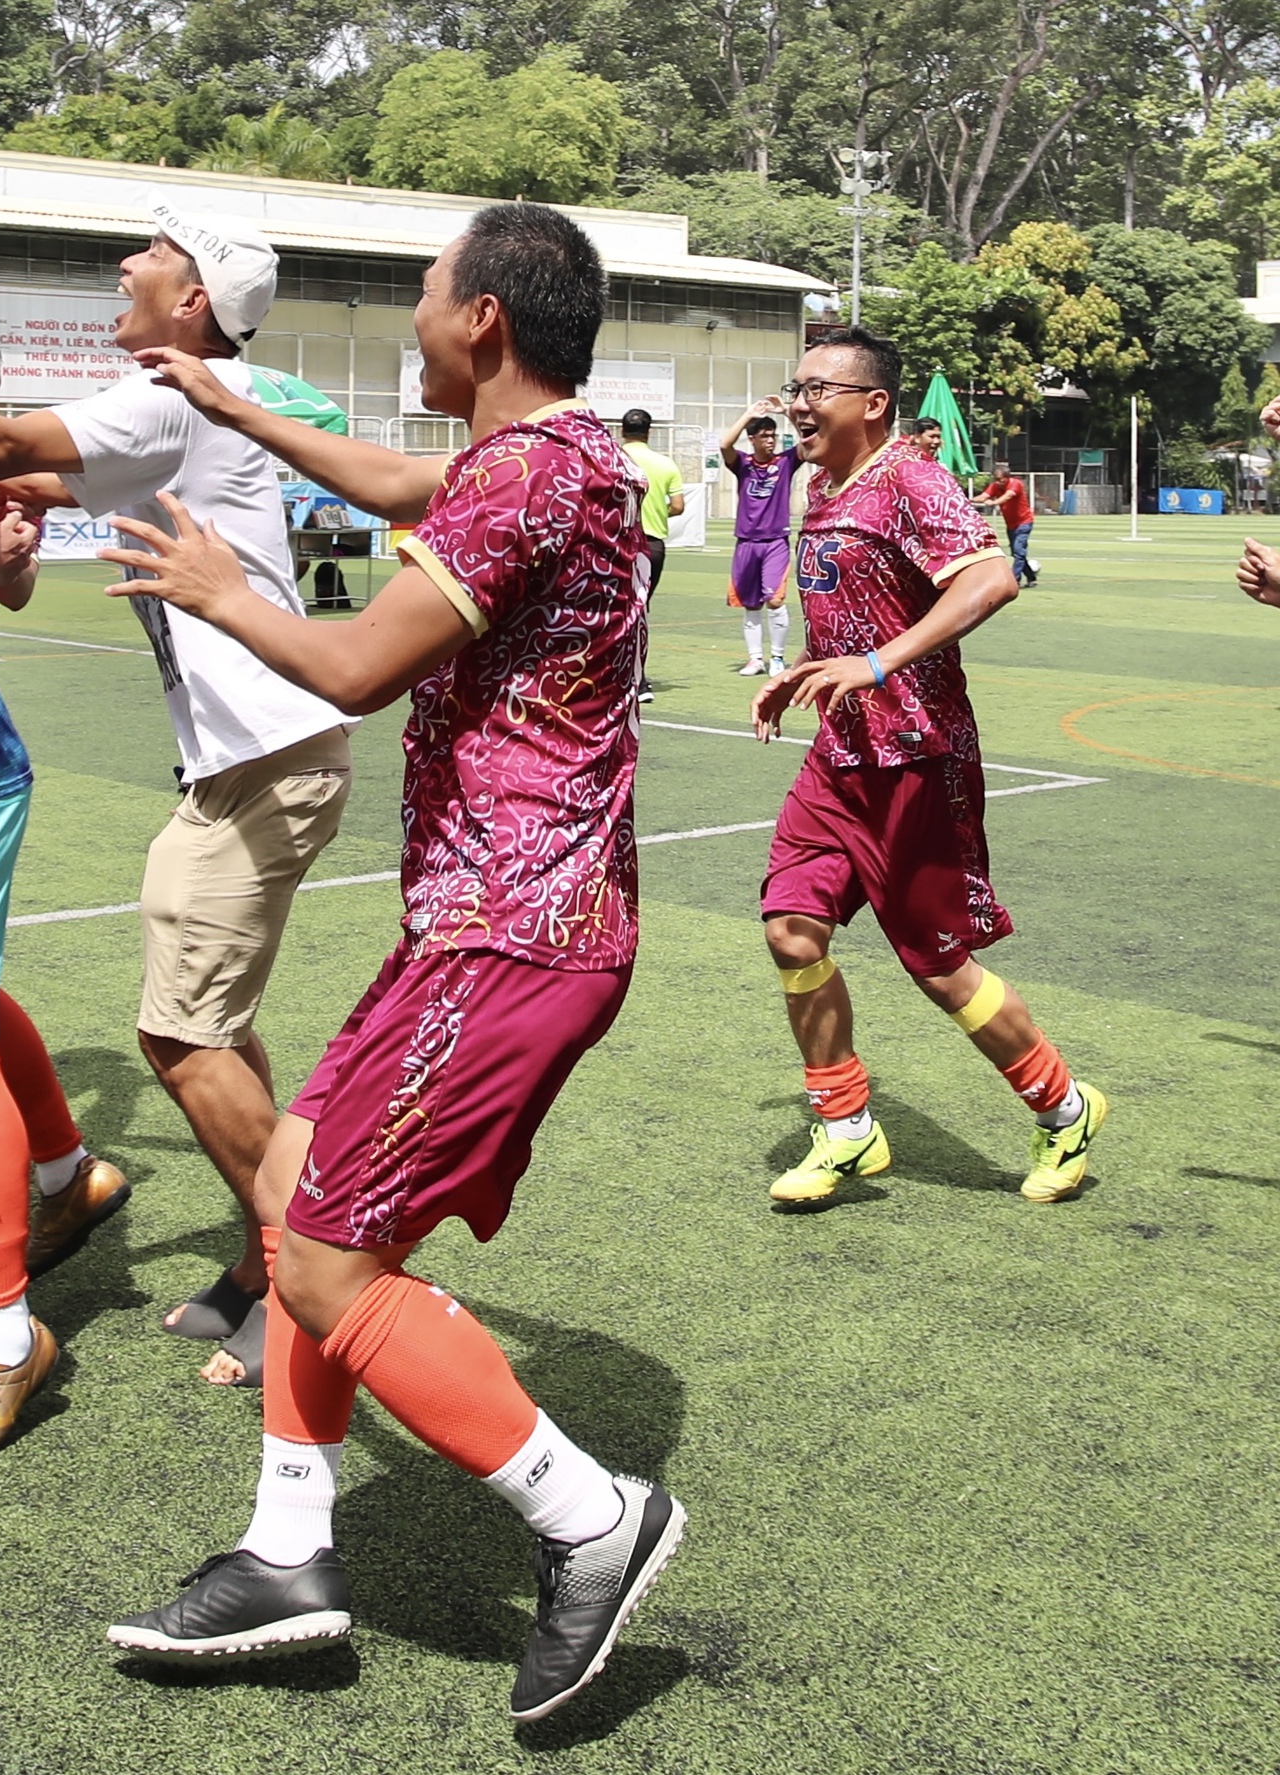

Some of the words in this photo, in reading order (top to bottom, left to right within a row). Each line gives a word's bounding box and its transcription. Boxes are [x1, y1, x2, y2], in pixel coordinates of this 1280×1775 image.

[153, 204, 234, 264] BOSTON
[2, 365, 42, 377] KHÔNG
[41, 521, 111, 547] EXU
[797, 535, 840, 594] LS
